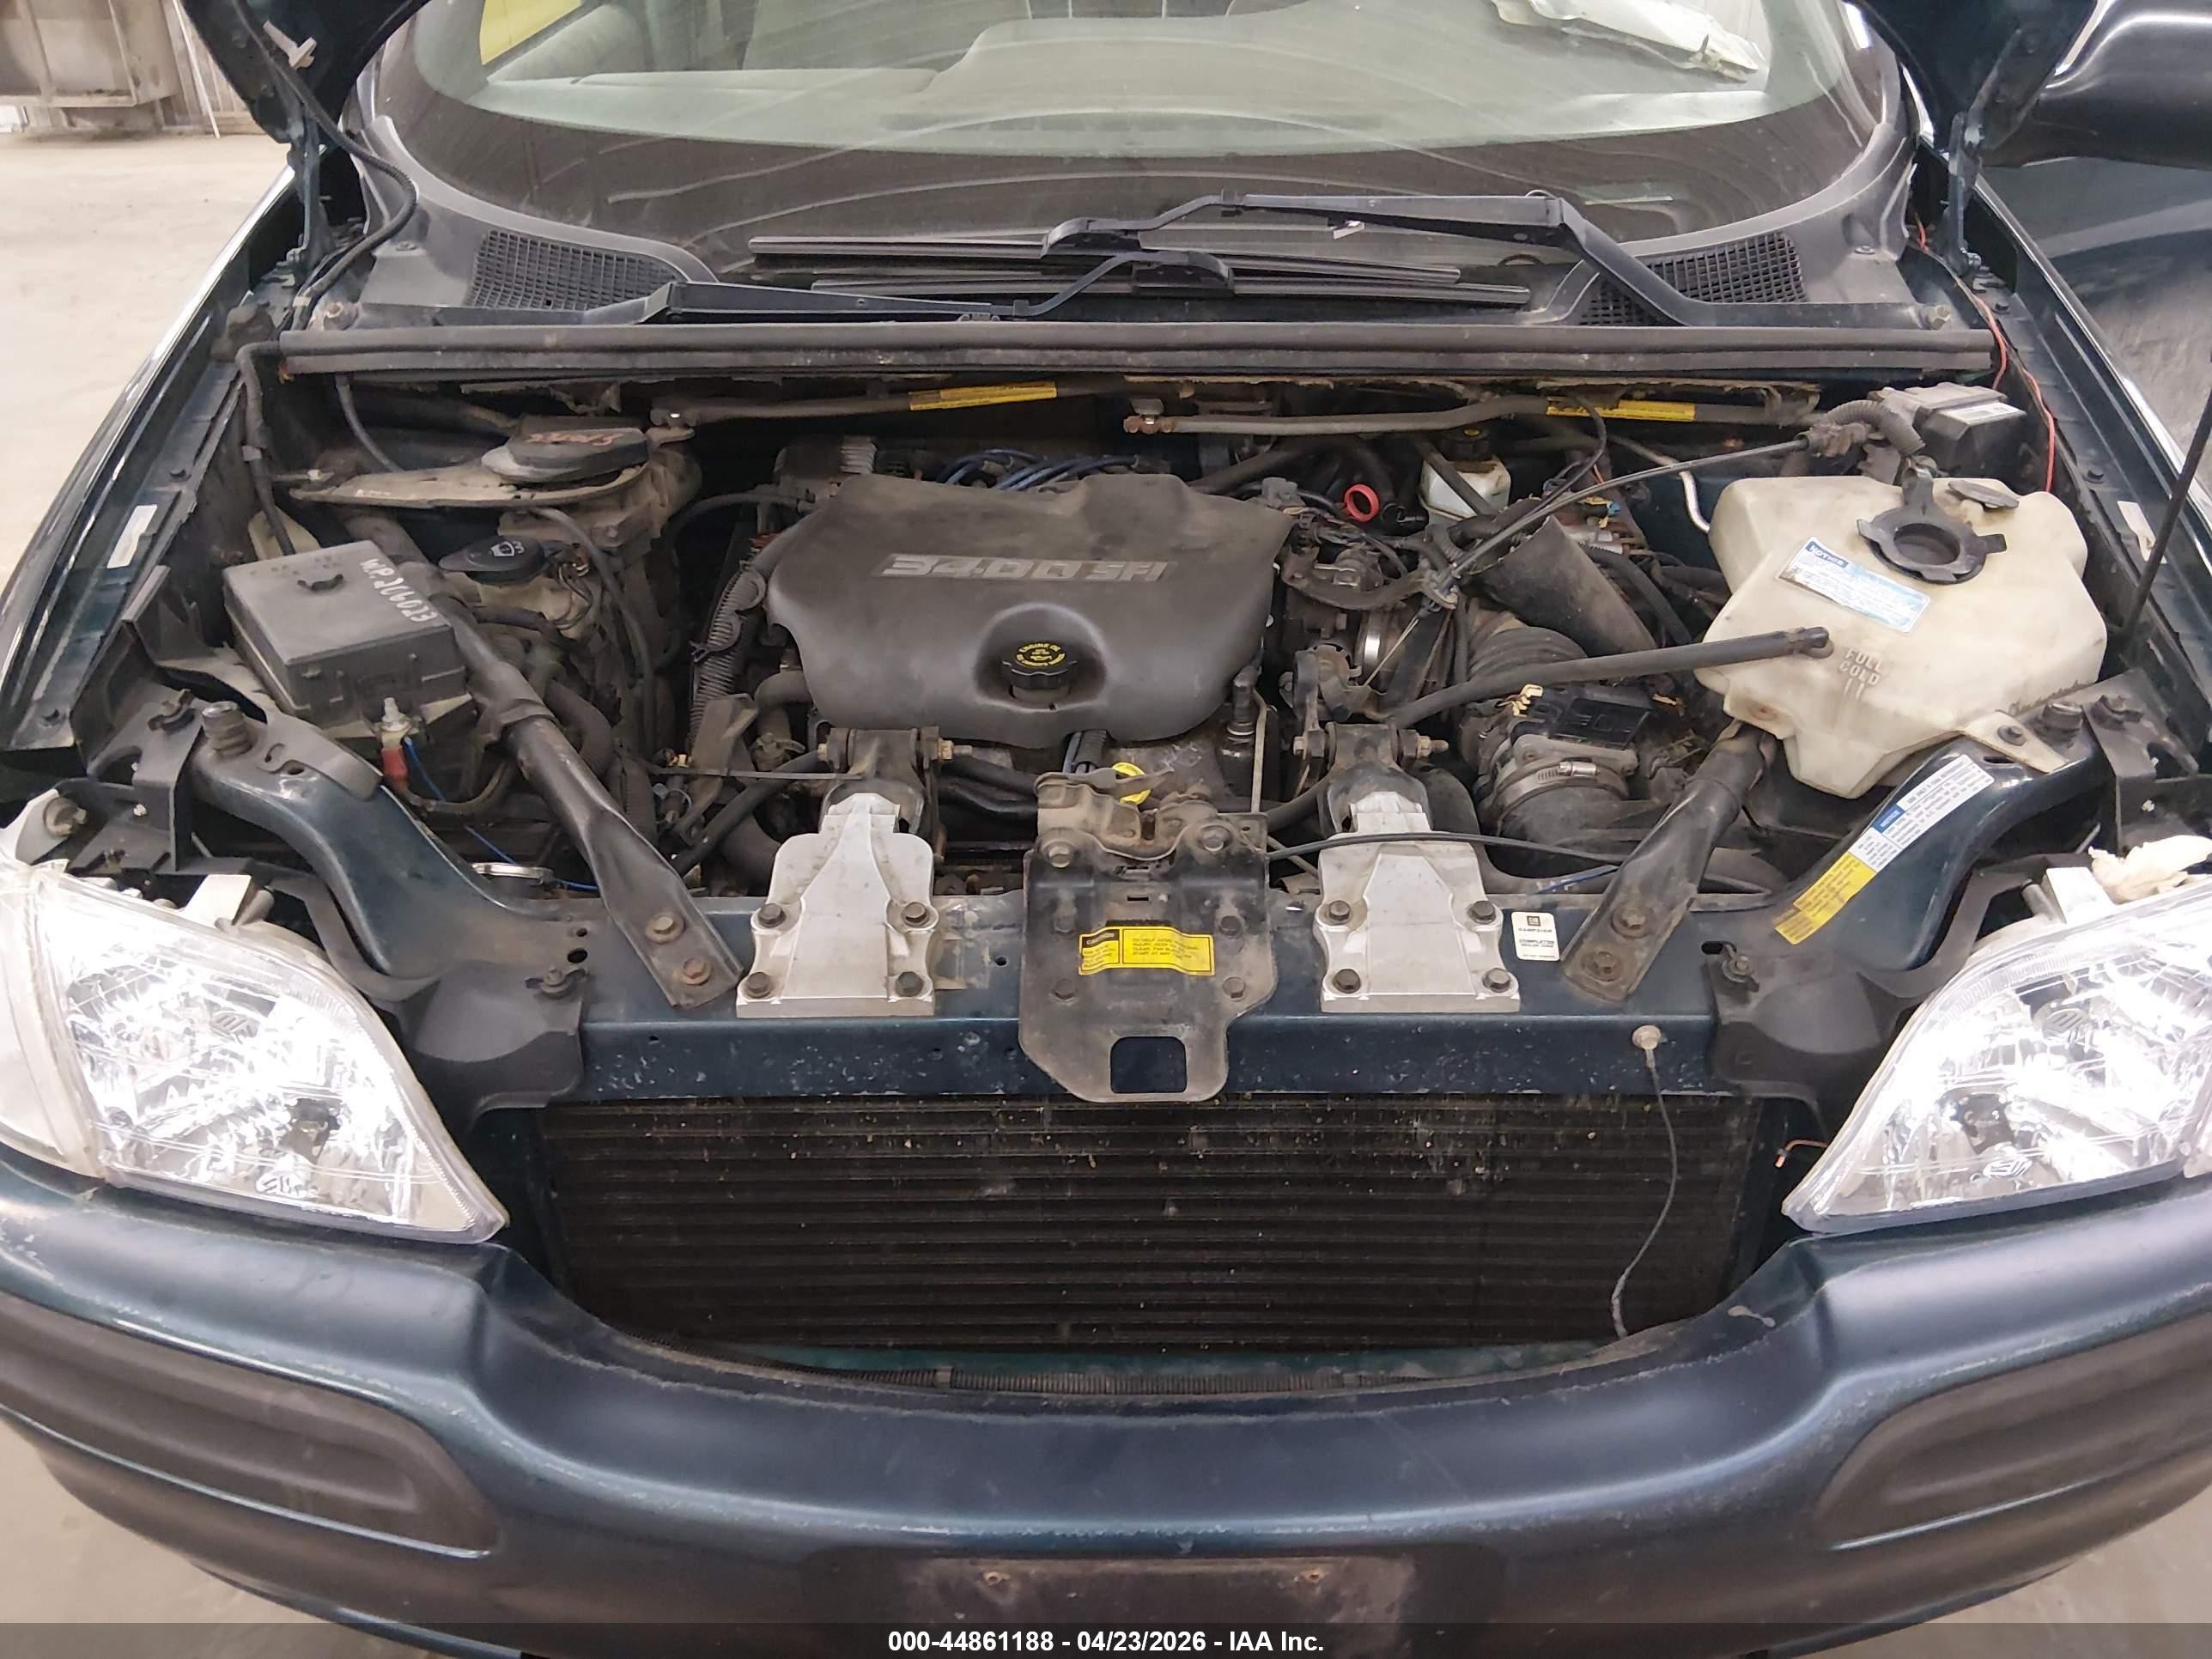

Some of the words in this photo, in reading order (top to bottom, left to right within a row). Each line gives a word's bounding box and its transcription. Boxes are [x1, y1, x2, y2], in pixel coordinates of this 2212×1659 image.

[882, 556, 1082, 580] 3400
[1085, 560, 1169, 582] SFI
[1839, 660, 1881, 685] COLD
[1844, 648, 1882, 672] FULL
